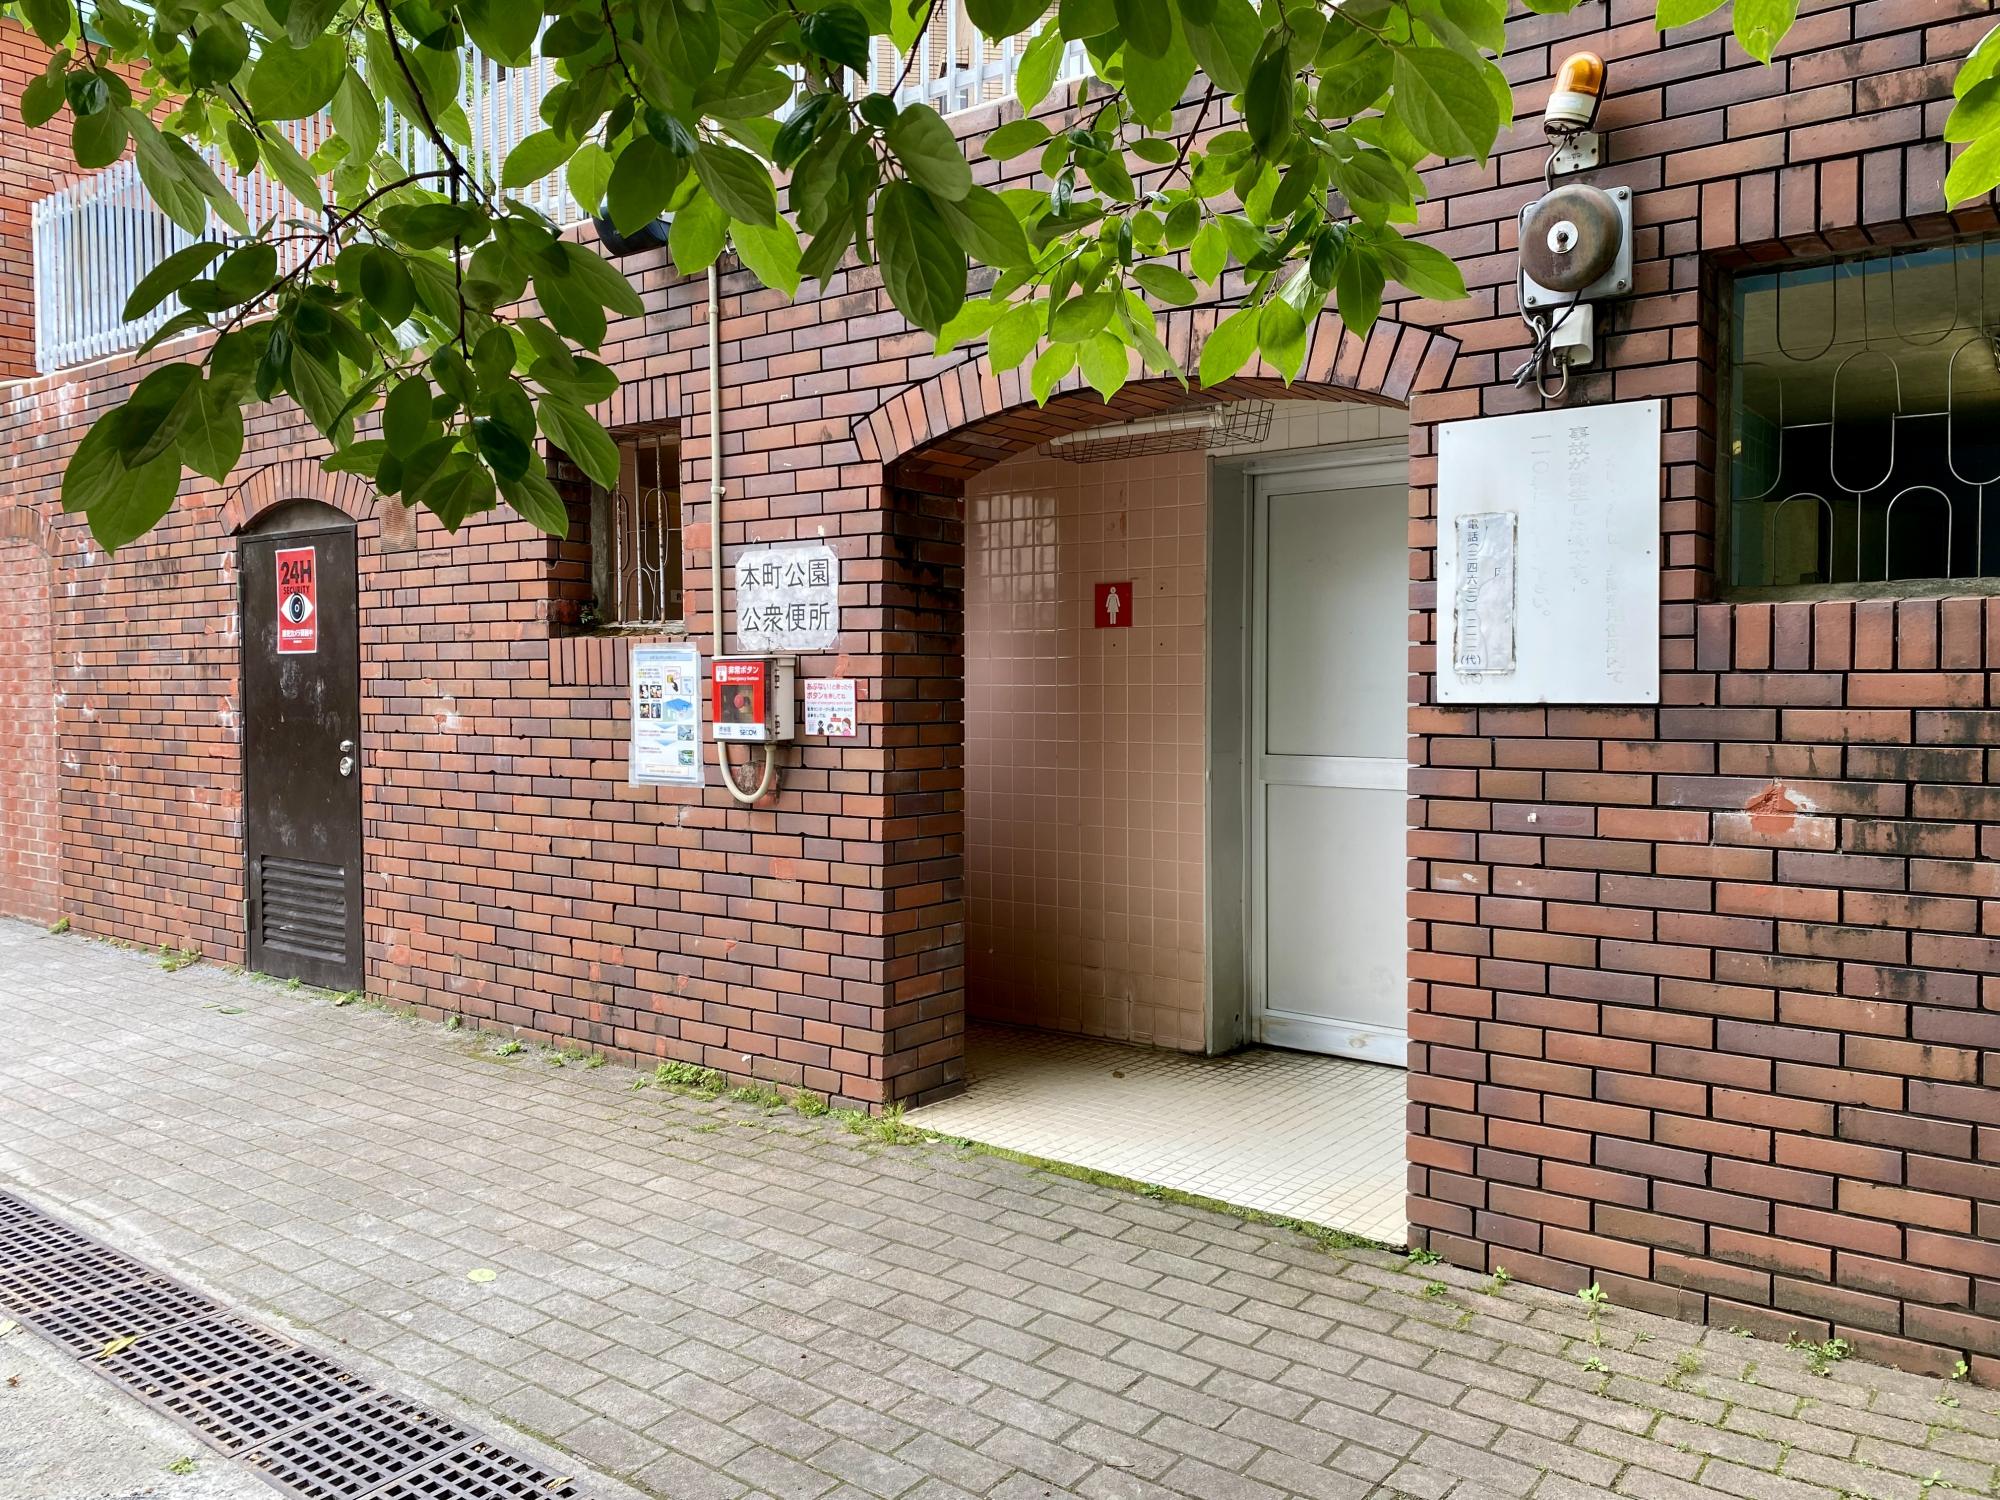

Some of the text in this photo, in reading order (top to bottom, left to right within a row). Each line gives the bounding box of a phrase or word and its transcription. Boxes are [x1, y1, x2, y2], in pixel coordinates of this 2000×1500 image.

[280, 560, 312, 585] 24H
[740, 558, 830, 592] 本町公園
[283, 585, 309, 594] SECURITY
[742, 602, 831, 633] 公衆便所
[728, 665, 760, 675] 非常ボタン
